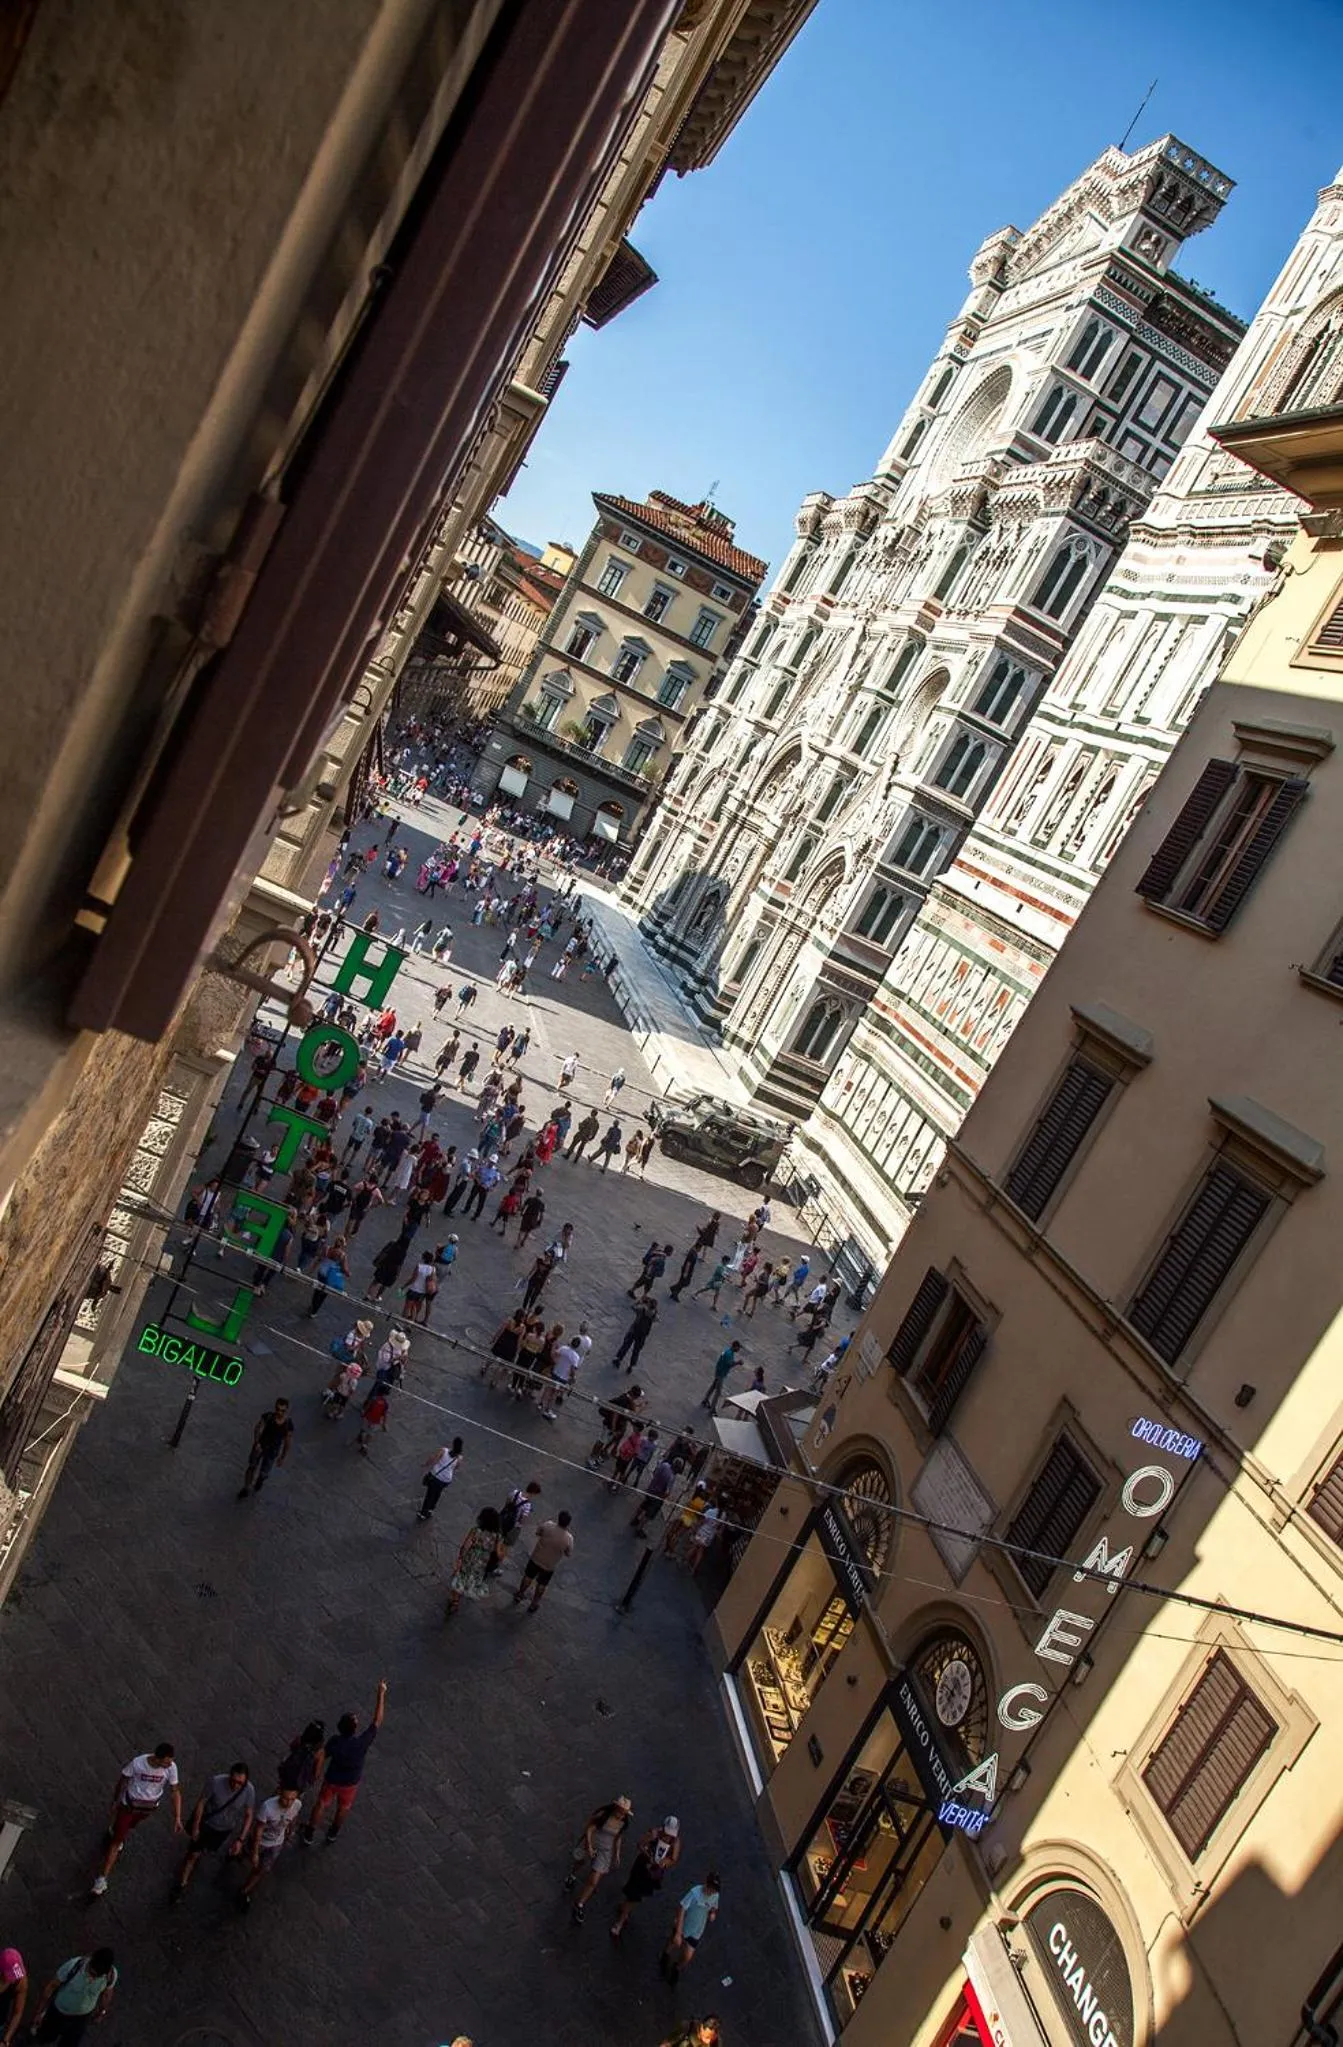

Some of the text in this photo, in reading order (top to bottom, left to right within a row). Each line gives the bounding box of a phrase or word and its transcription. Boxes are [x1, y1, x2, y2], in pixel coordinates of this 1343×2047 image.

[137, 1327, 243, 1386] BIGALLO
[1131, 1417, 1202, 1461] OROLOGERIA
[823, 1507, 847, 1556] ENRICO
[952, 1464, 1175, 1802] OMEGA
[899, 1683, 929, 1747] ENRICO
[928, 1745, 957, 1802] VERIT
